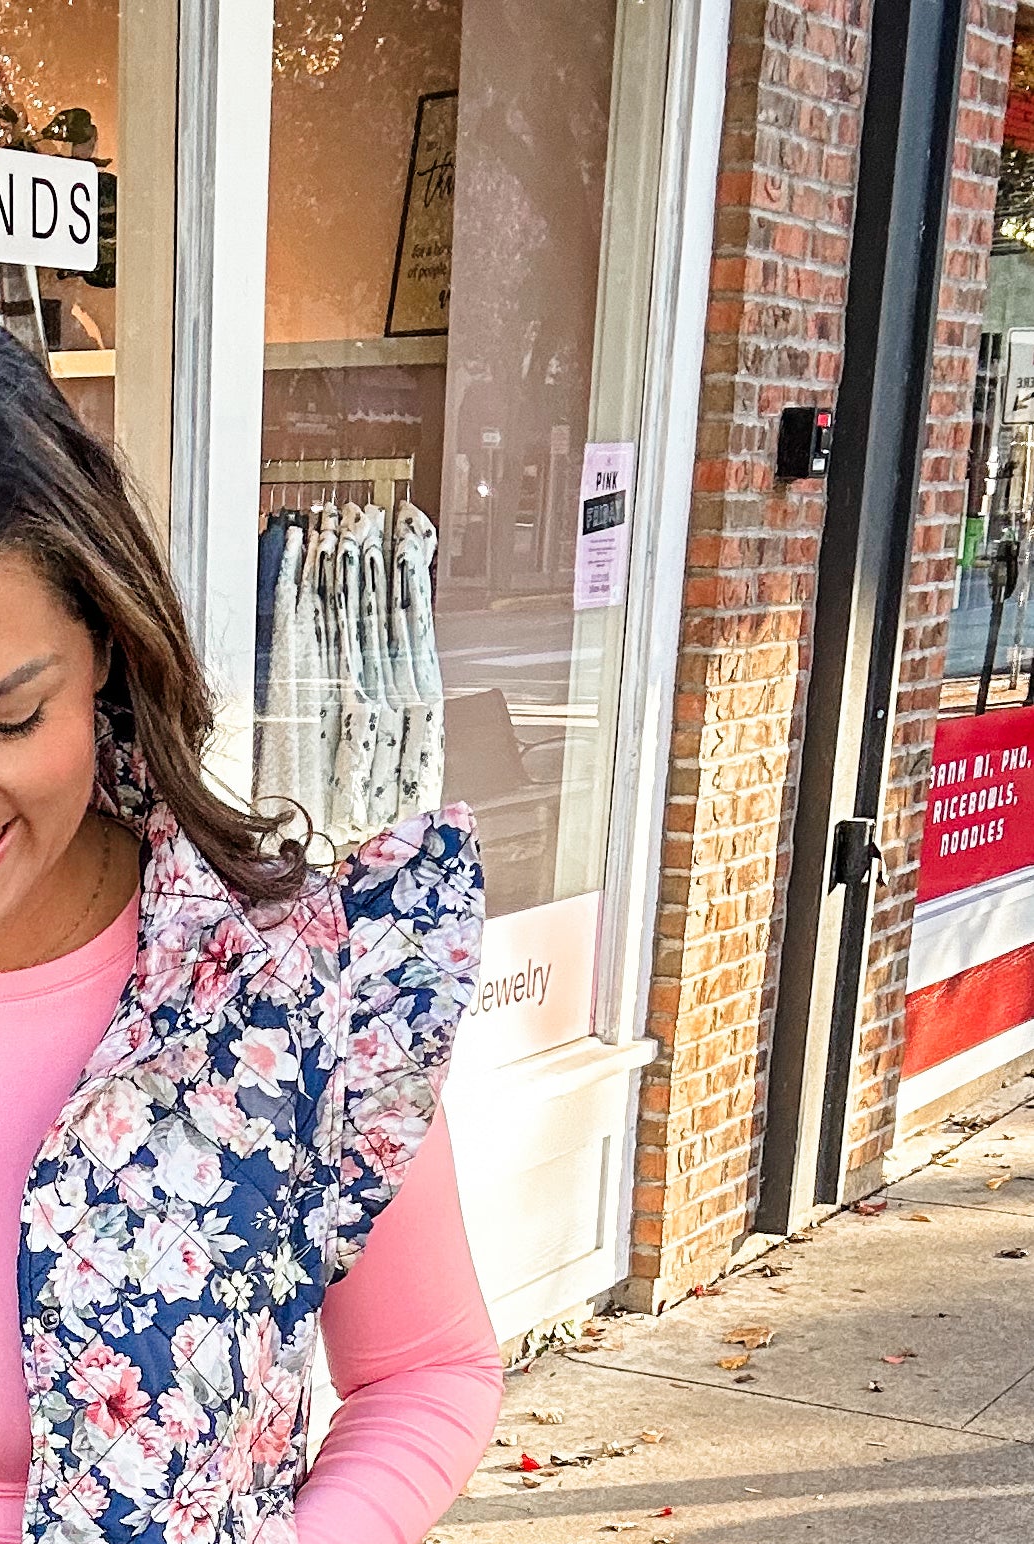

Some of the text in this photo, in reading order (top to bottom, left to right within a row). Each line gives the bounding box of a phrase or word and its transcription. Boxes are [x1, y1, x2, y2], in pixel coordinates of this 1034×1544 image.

[596, 470, 619, 491] PINK
[1000, 745, 1032, 773] PHO,
[932, 781, 1018, 825] RICEBOWLS,
[939, 817, 1005, 858] NOODLES
[469, 958, 552, 1017] Jewelry
